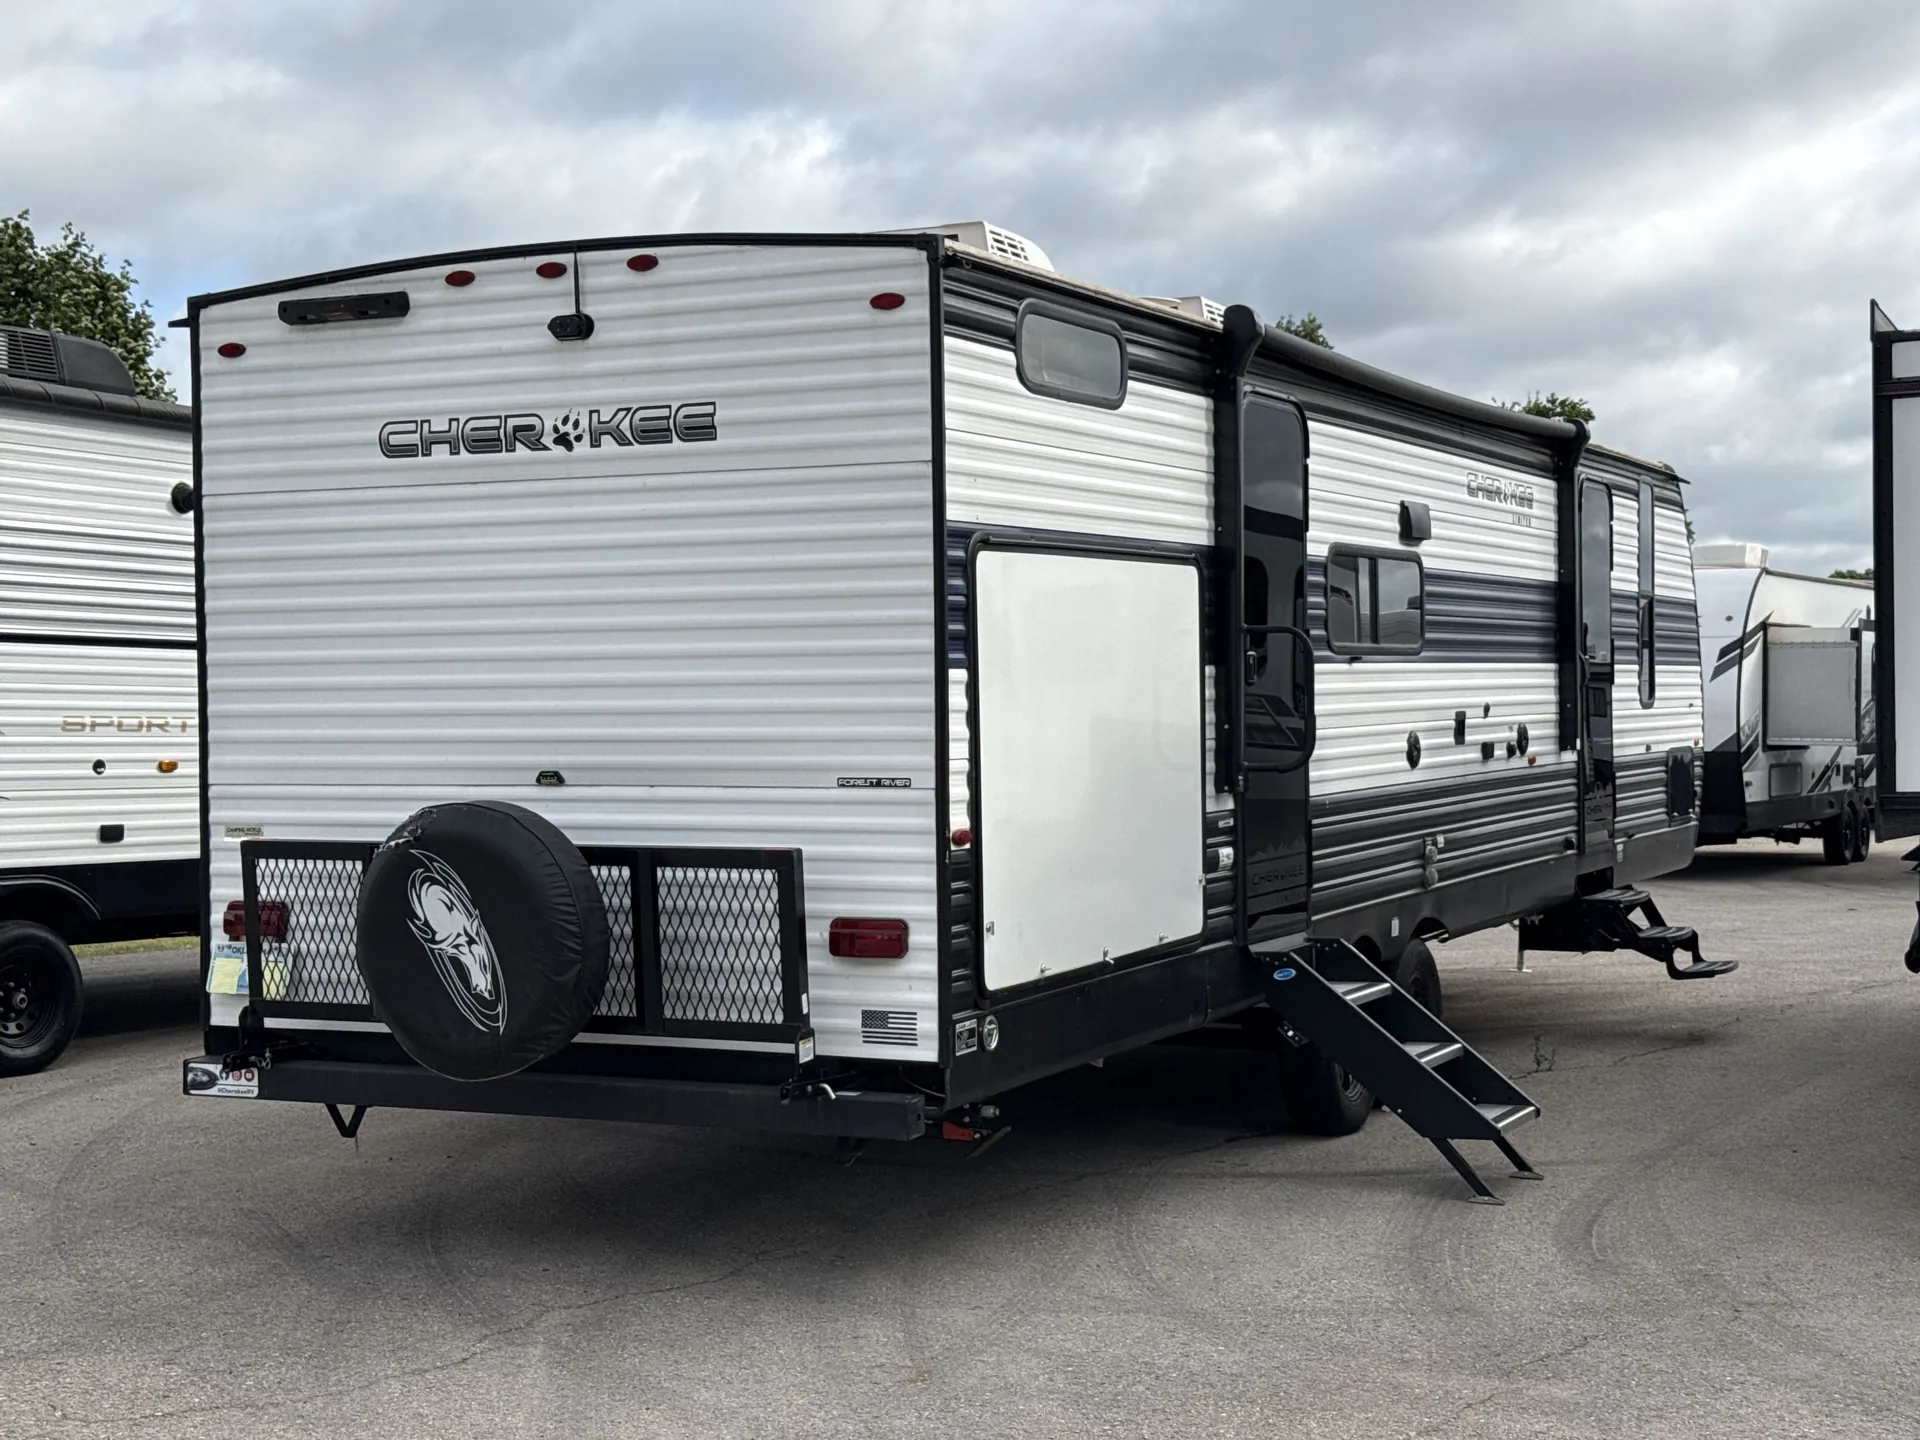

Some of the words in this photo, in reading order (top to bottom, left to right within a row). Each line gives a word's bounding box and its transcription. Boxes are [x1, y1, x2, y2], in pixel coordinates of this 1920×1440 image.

[60, 715, 197, 734] SPORT
[838, 778, 878, 787] FOREST
[880, 778, 911, 787] RIVER
